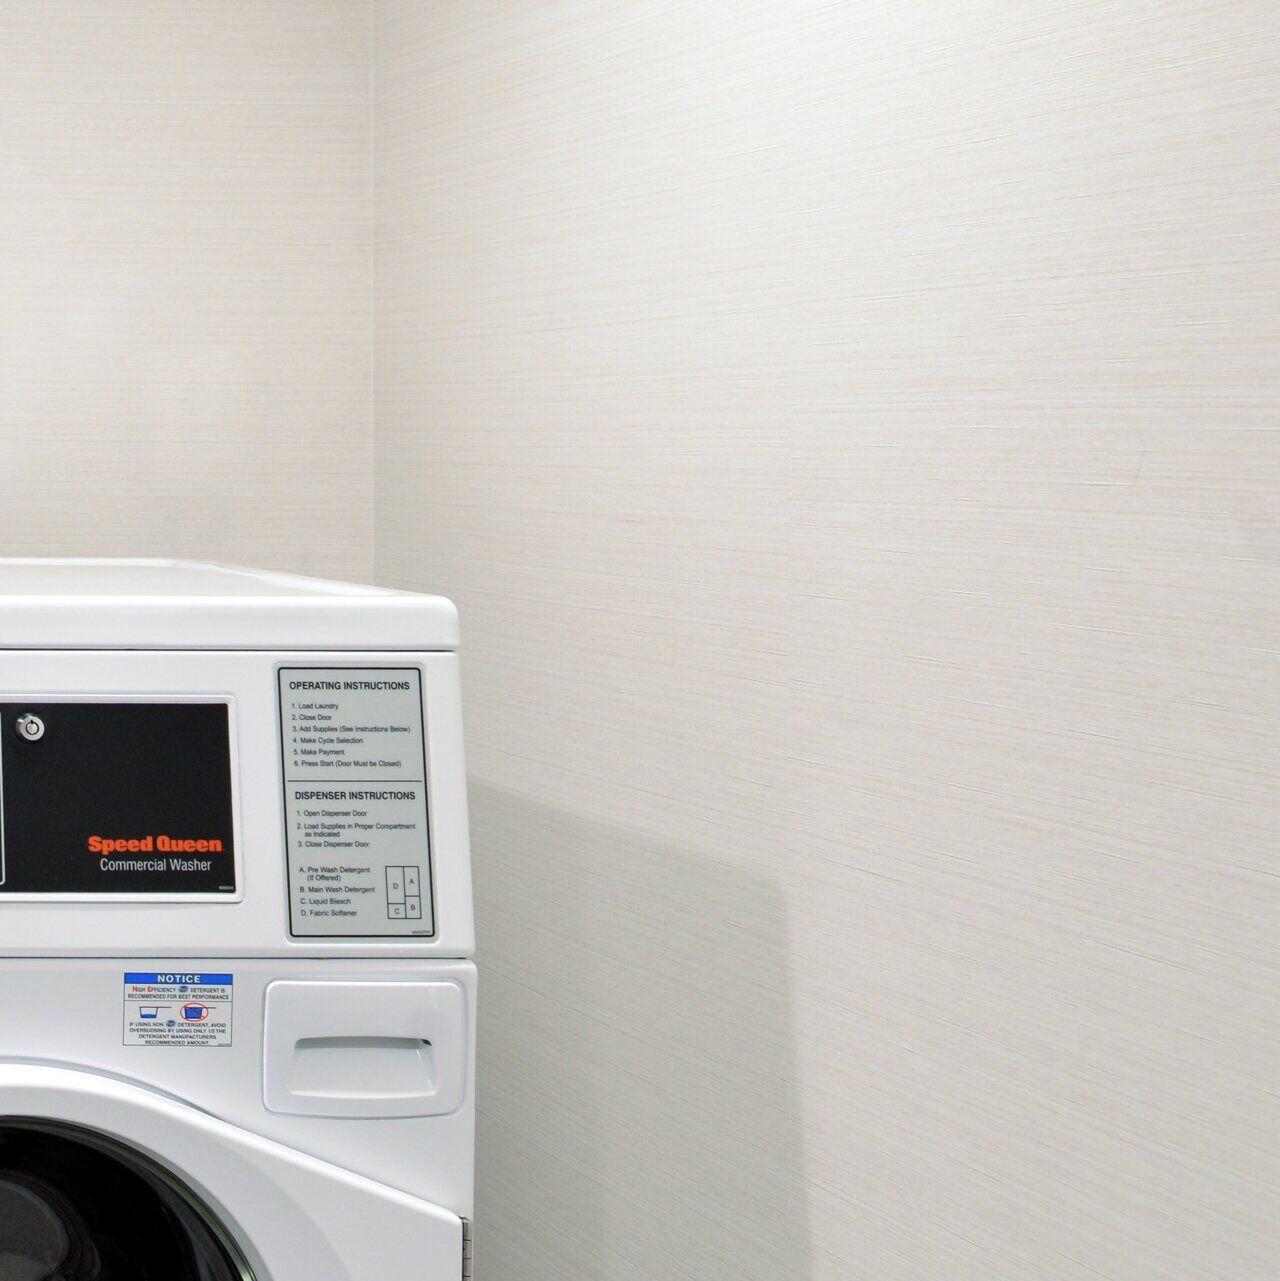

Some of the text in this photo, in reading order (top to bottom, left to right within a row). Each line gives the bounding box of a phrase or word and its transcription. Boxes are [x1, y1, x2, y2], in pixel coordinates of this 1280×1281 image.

[289, 681, 410, 690] OPERATING INSTRUCTIONS
[318, 737, 335, 745] Cycle
[295, 791, 416, 800] DISPENSER INSTRUCTIONS
[88, 835, 223, 855] Speed Queen
[100, 858, 212, 872] Commercial Washer
[309, 898, 328, 906] Liquid
[157, 975, 201, 983] NOTICE
